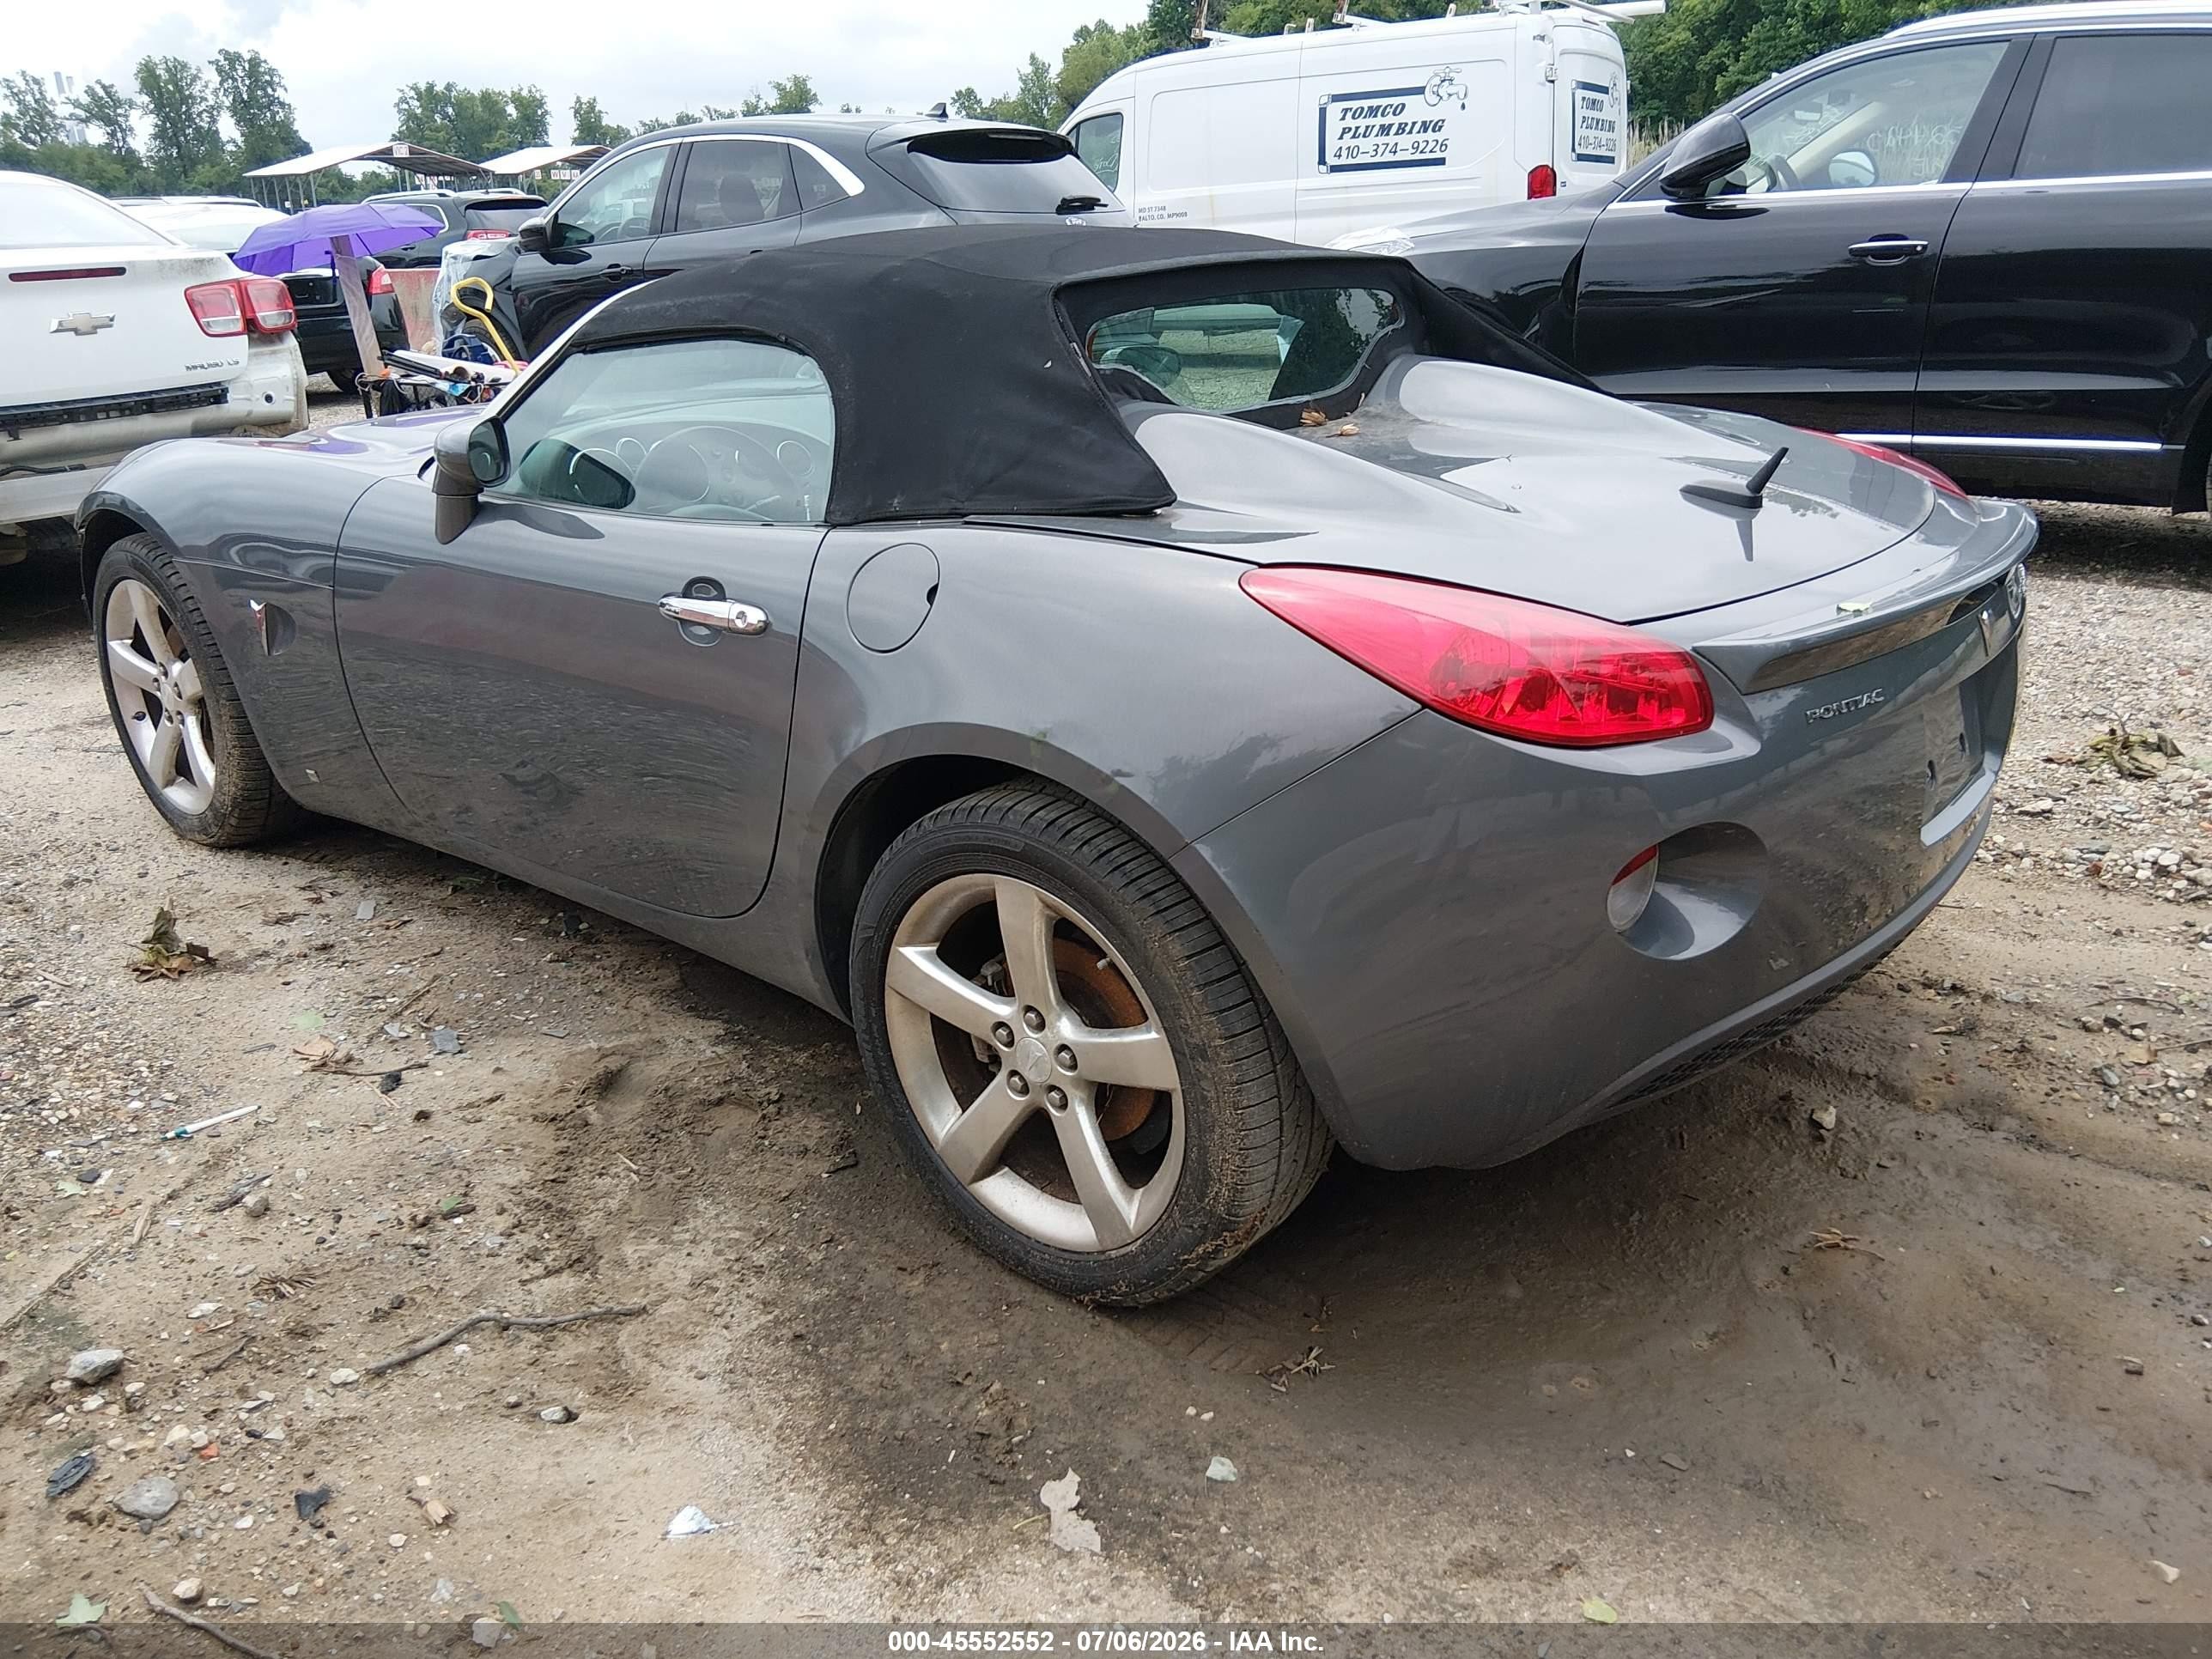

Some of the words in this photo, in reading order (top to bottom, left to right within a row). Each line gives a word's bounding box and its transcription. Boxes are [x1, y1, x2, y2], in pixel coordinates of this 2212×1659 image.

[1339, 102, 1407, 121] TOMCO
[1580, 95, 1604, 112] TOMCO
[1337, 118, 1446, 140] PLUMBING
[1579, 115, 1616, 133] PLUMBING
[1333, 137, 1449, 161] 410-374-9226
[1577, 134, 1617, 152] 410-374-9226
[1806, 688, 1885, 724] PONTIAC
